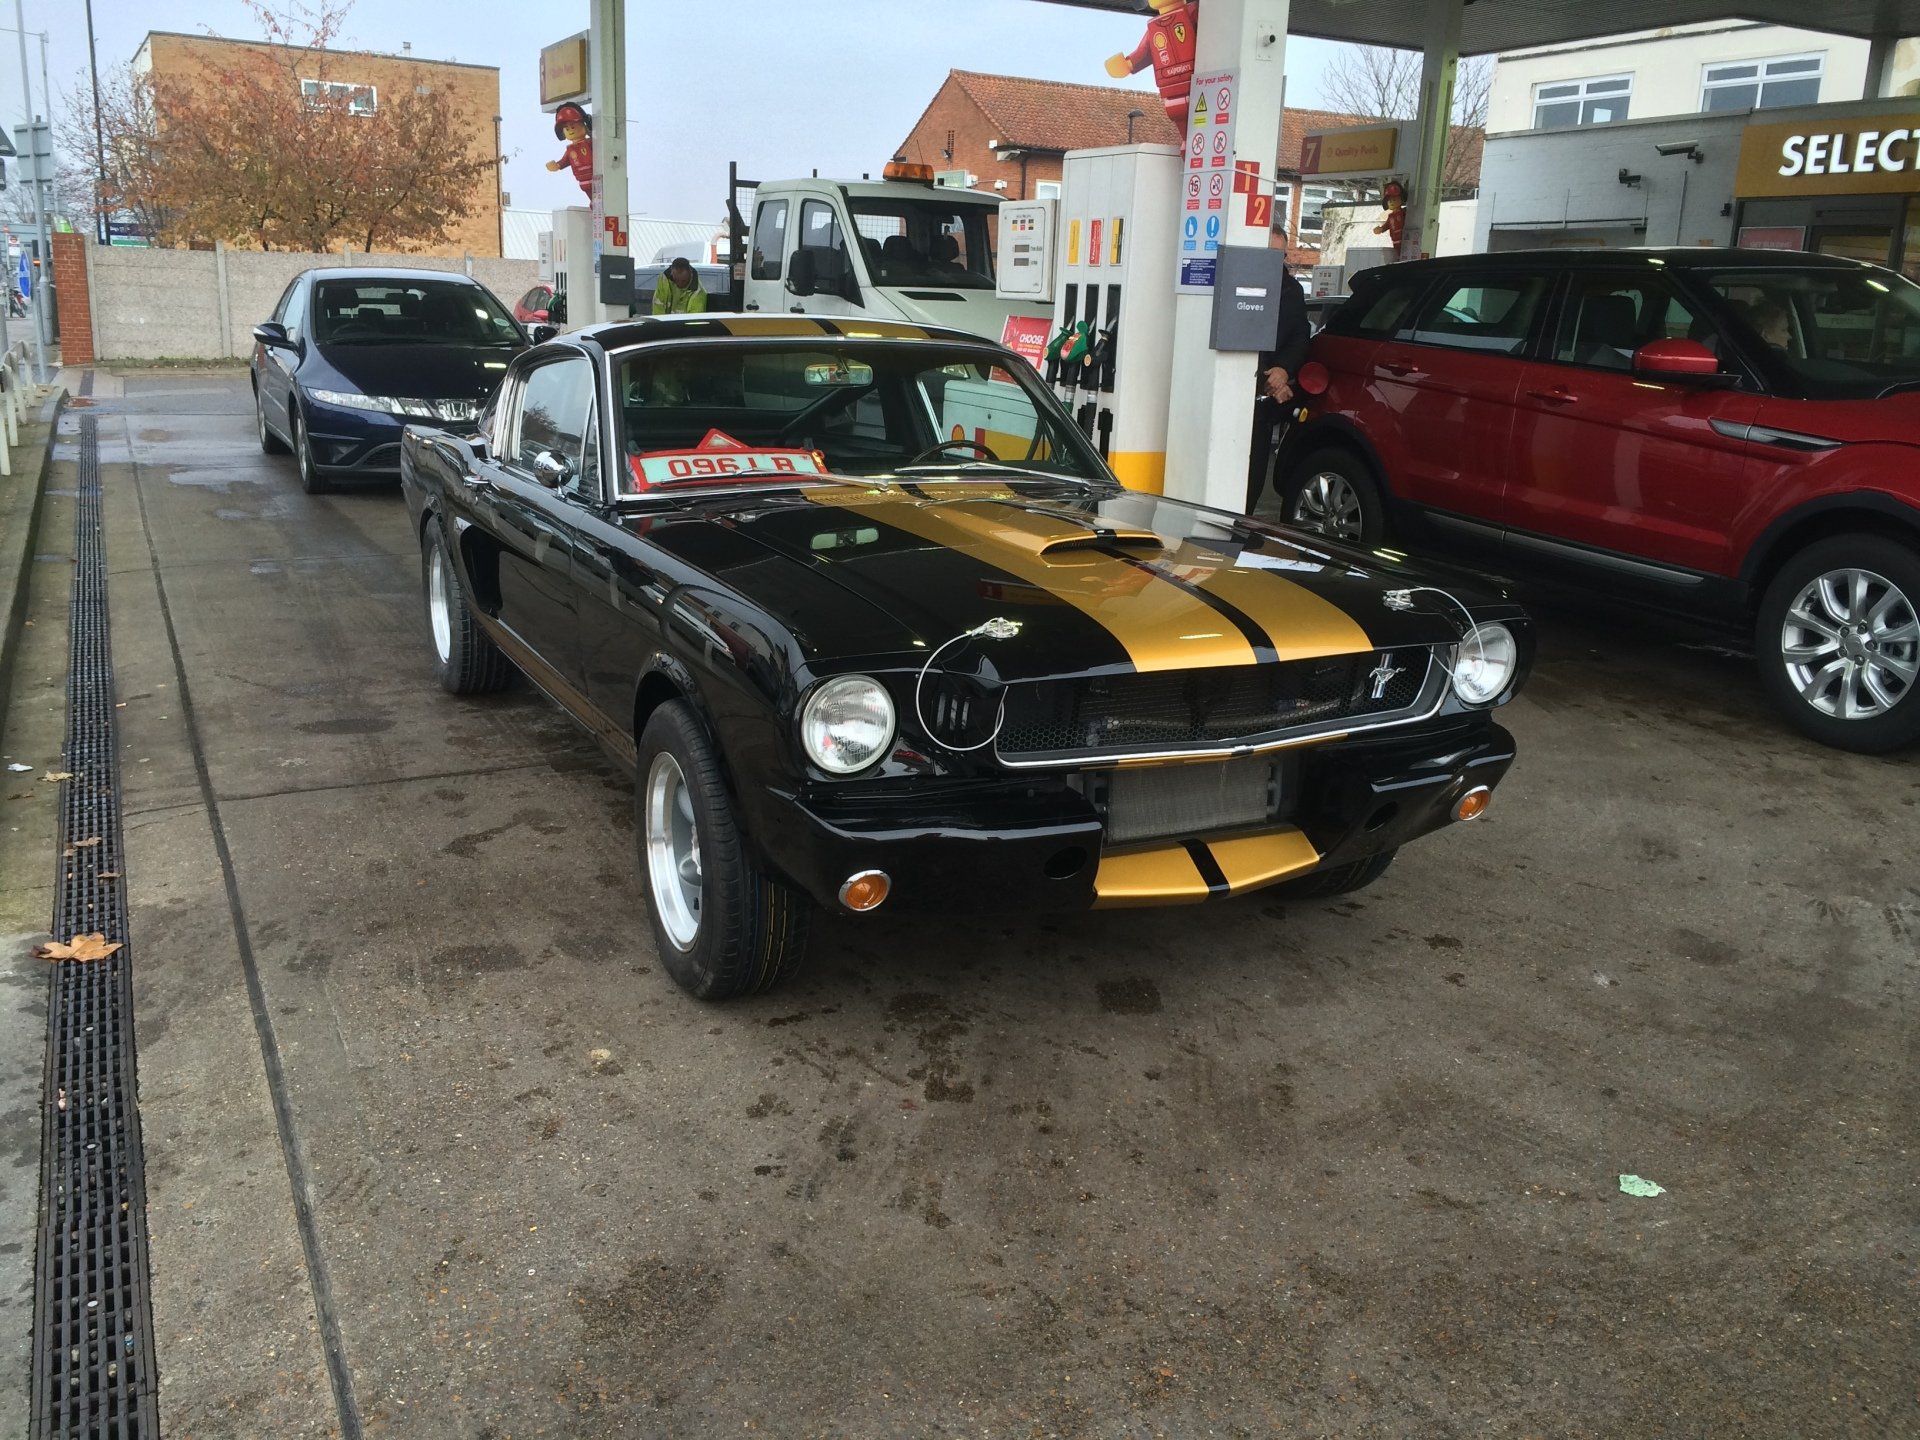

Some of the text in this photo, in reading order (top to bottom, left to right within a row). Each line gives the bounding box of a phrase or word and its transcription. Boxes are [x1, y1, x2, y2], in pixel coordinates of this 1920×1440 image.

[1196, 74, 1234, 87] For your safety
[1305, 142, 1318, 168] 7
[1244, 163, 1252, 192] 1
[1252, 197, 1266, 225] 2
[608, 217, 616, 231] 5
[616, 233, 624, 246] 6
[1236, 301, 1265, 311] Gloves
[1019, 333, 1044, 345] CHOOSE
[668, 458, 740, 477] 096
